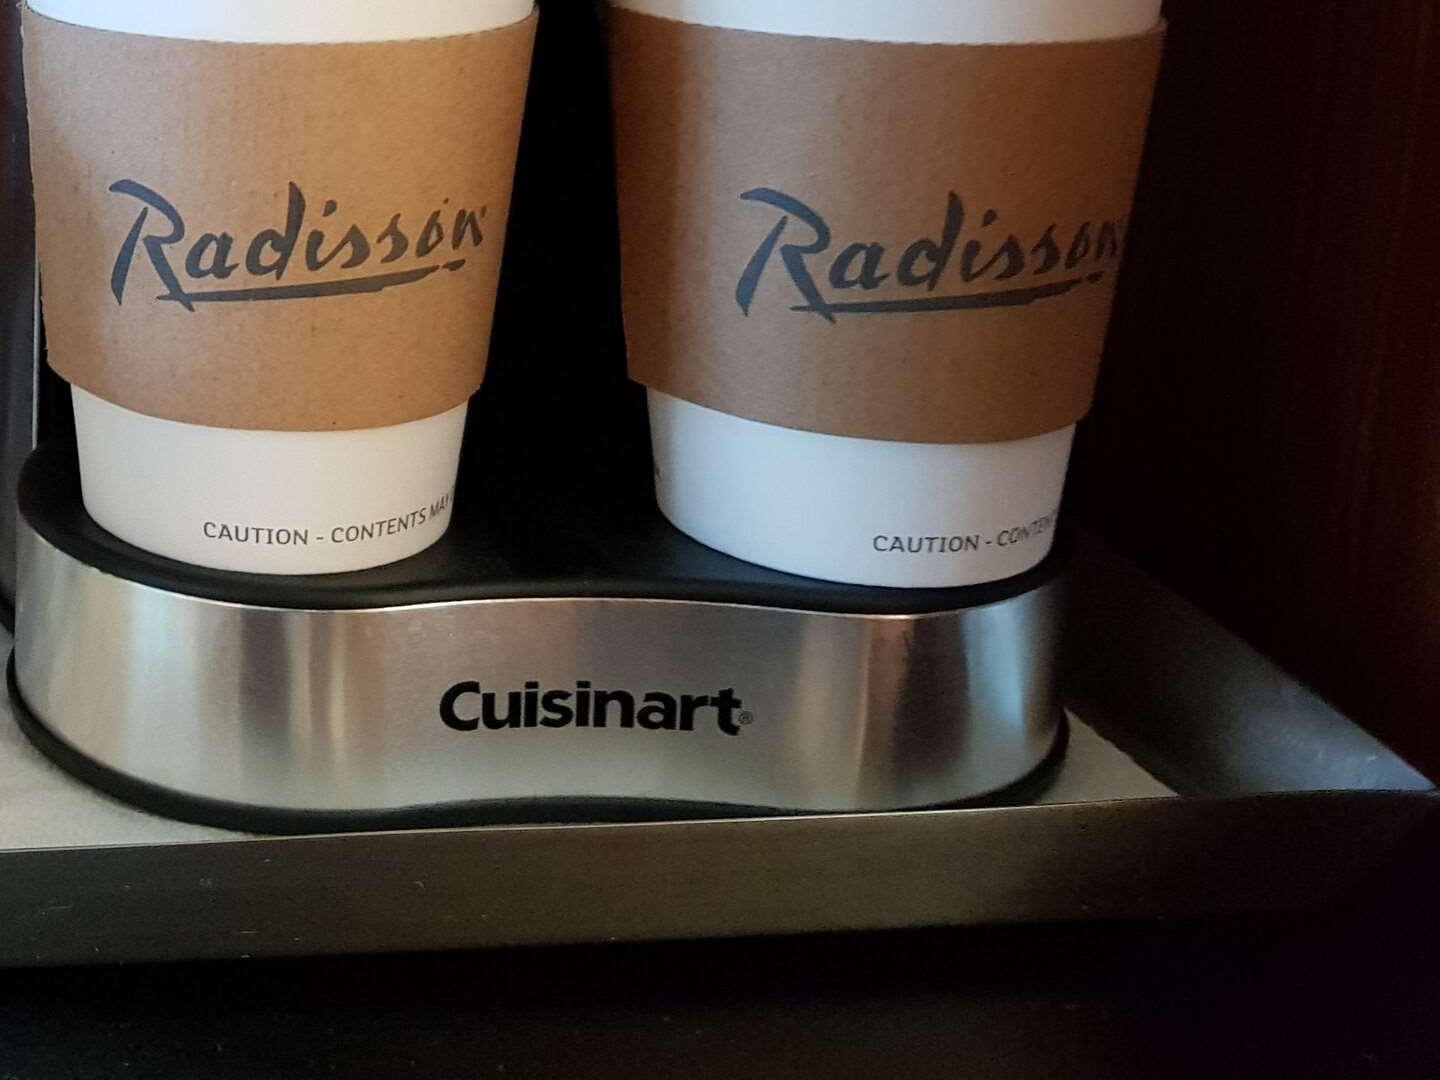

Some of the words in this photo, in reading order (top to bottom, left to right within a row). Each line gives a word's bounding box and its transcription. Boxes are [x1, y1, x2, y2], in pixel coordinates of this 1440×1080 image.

[109, 179, 486, 312] Radisson
[735, 187, 1119, 324] Radisson
[203, 521, 309, 545] CAUTION
[331, 507, 427, 544] CONTENTS
[873, 535, 979, 553] CAUTION
